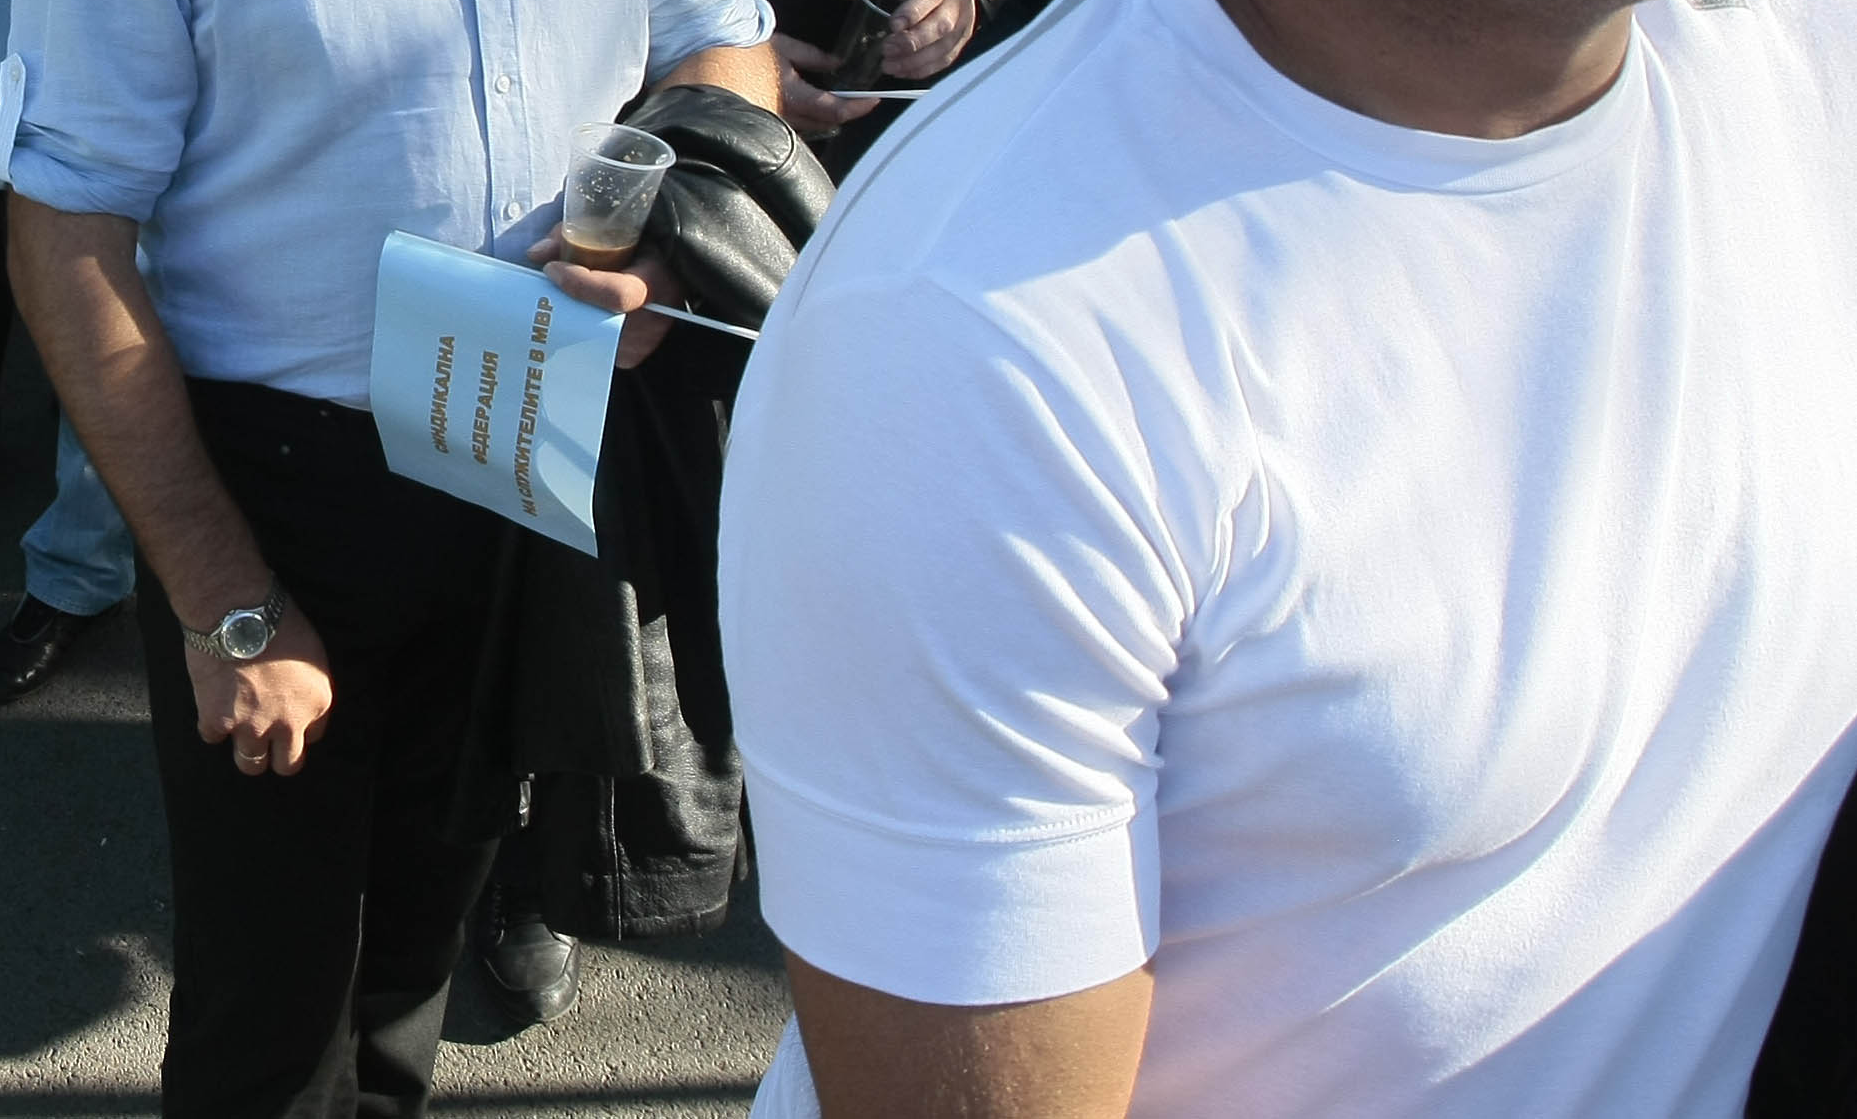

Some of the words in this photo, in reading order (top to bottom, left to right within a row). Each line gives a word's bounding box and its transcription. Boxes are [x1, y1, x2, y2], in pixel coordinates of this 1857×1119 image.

[531, 296, 554, 345] МВР
[528, 349, 546, 365] В
[430, 335, 456, 454] СИНДИКАЛНА
